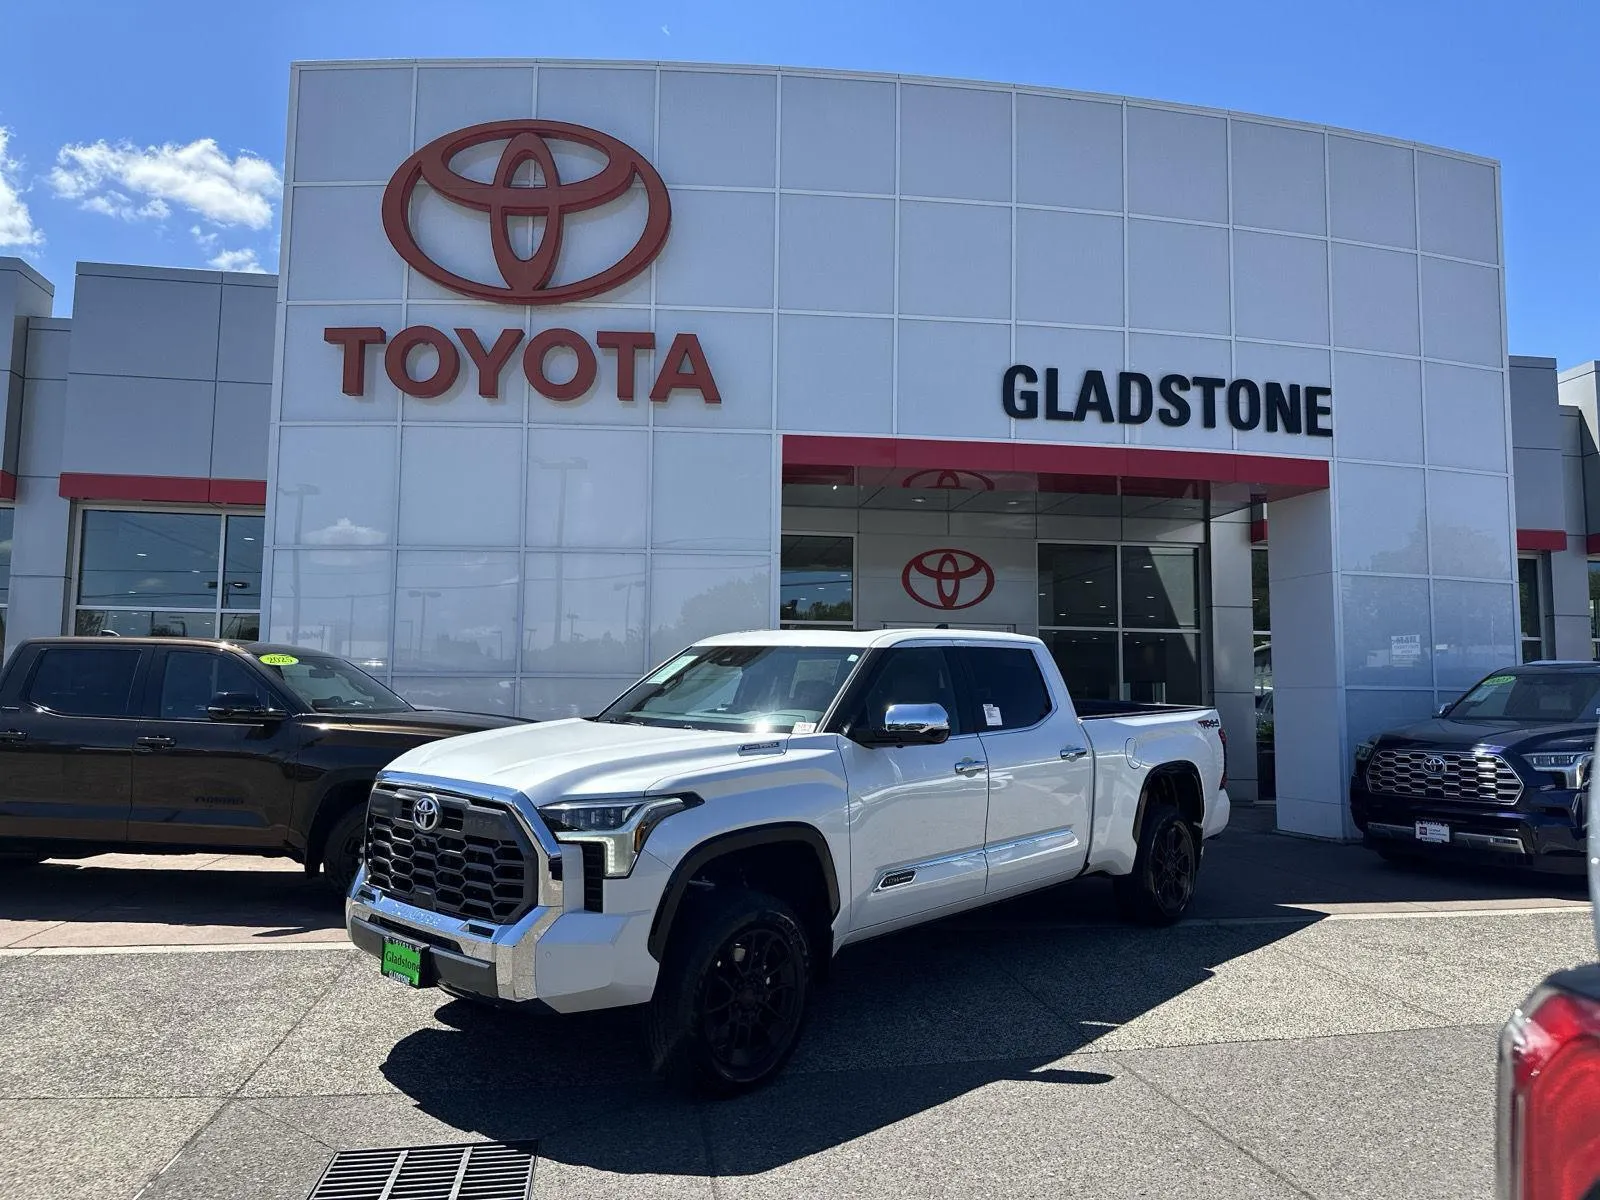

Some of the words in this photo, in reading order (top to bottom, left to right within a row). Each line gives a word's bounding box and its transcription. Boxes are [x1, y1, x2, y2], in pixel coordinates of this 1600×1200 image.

[324, 325, 721, 403] TOYOTA
[1002, 364, 1333, 437] GLADSTONE
[269, 656, 293, 664] 2025
[385, 950, 420, 972] Gladstone
